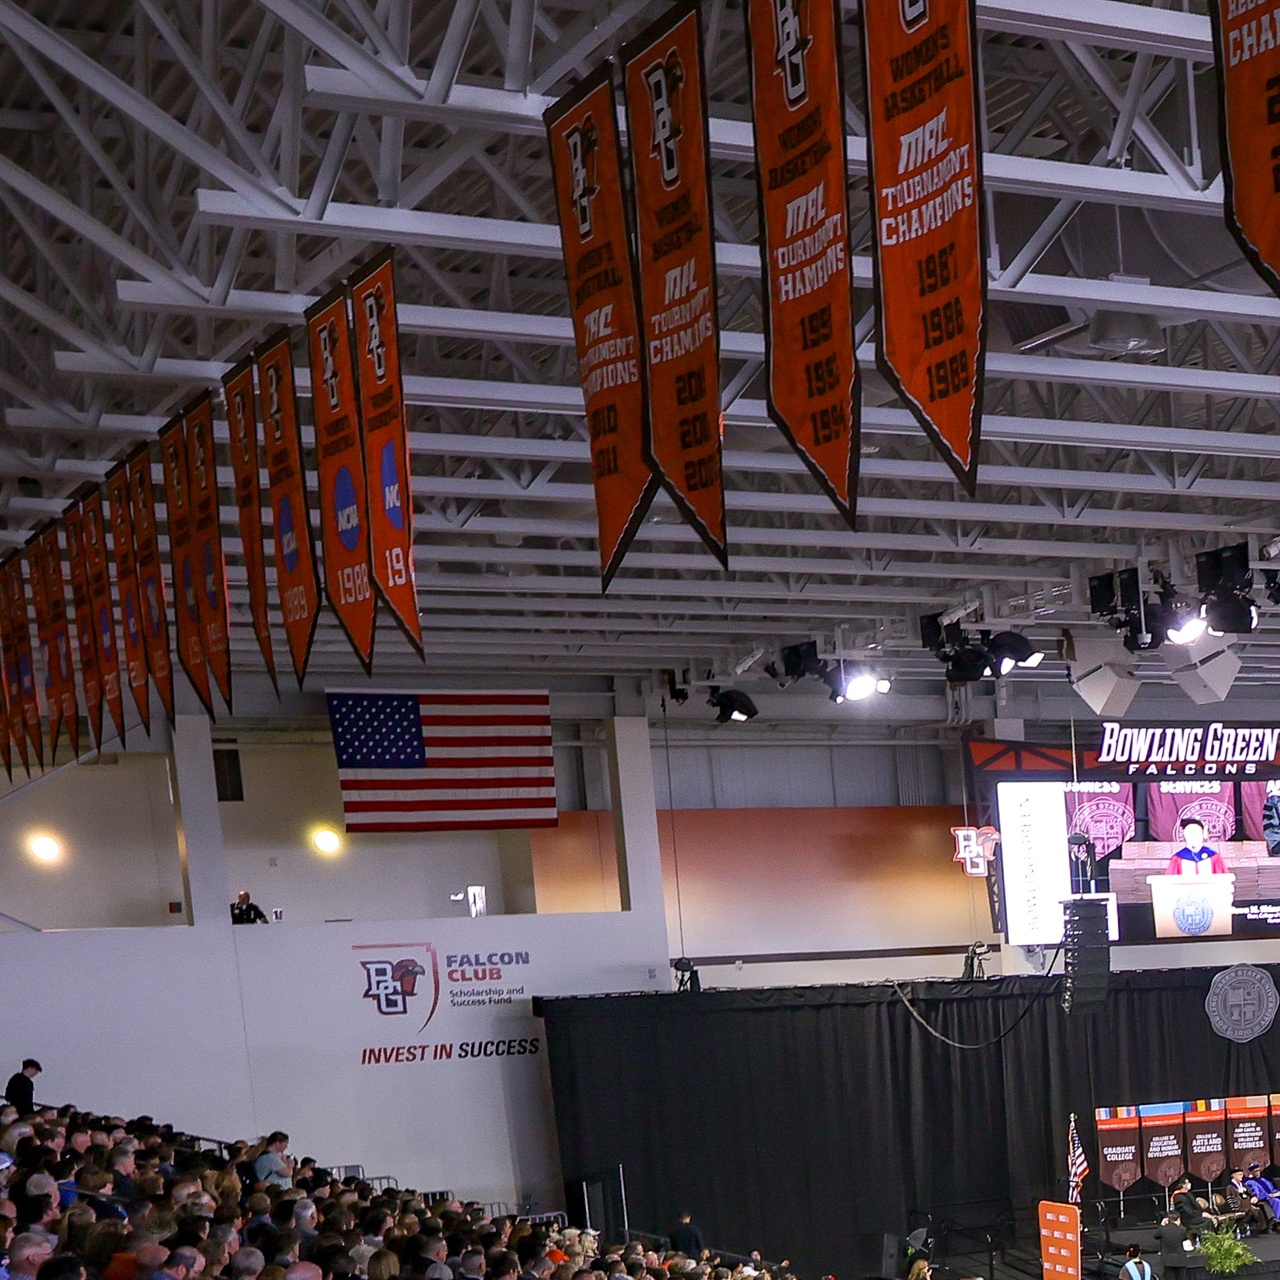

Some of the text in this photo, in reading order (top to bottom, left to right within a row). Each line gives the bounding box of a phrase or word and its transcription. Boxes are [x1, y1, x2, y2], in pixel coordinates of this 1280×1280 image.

[898, 107, 949, 175] MAC
[917, 242, 959, 297] 1987
[926, 349, 971, 403] 1989
[385, 547, 407, 588] 19
[1098, 722, 1280, 762] BOWLING GREEN
[1128, 763, 1257, 775] FALCONS
[955, 829, 986, 874] BG
[446, 951, 530, 968] FALCON
[447, 967, 502, 982] CLUB
[364, 962, 405, 1013] BG
[450, 986, 525, 999] Scholarship and
[450, 996, 512, 1007] Success Fund
[361, 1038, 540, 1065] INVEST IN SUCCESS
[1103, 1145, 1136, 1155] GRADUATE
[1150, 1139, 1177, 1147] EDUCATION
[1192, 1139, 1208, 1147] ARTS
[1193, 1144, 1222, 1153] SCIENCES
[1233, 1140, 1264, 1150] BUSINESS
[1106, 1153, 1134, 1162] COLLEGE
[1148, 1149, 1181, 1158] DEVELOPMENT
